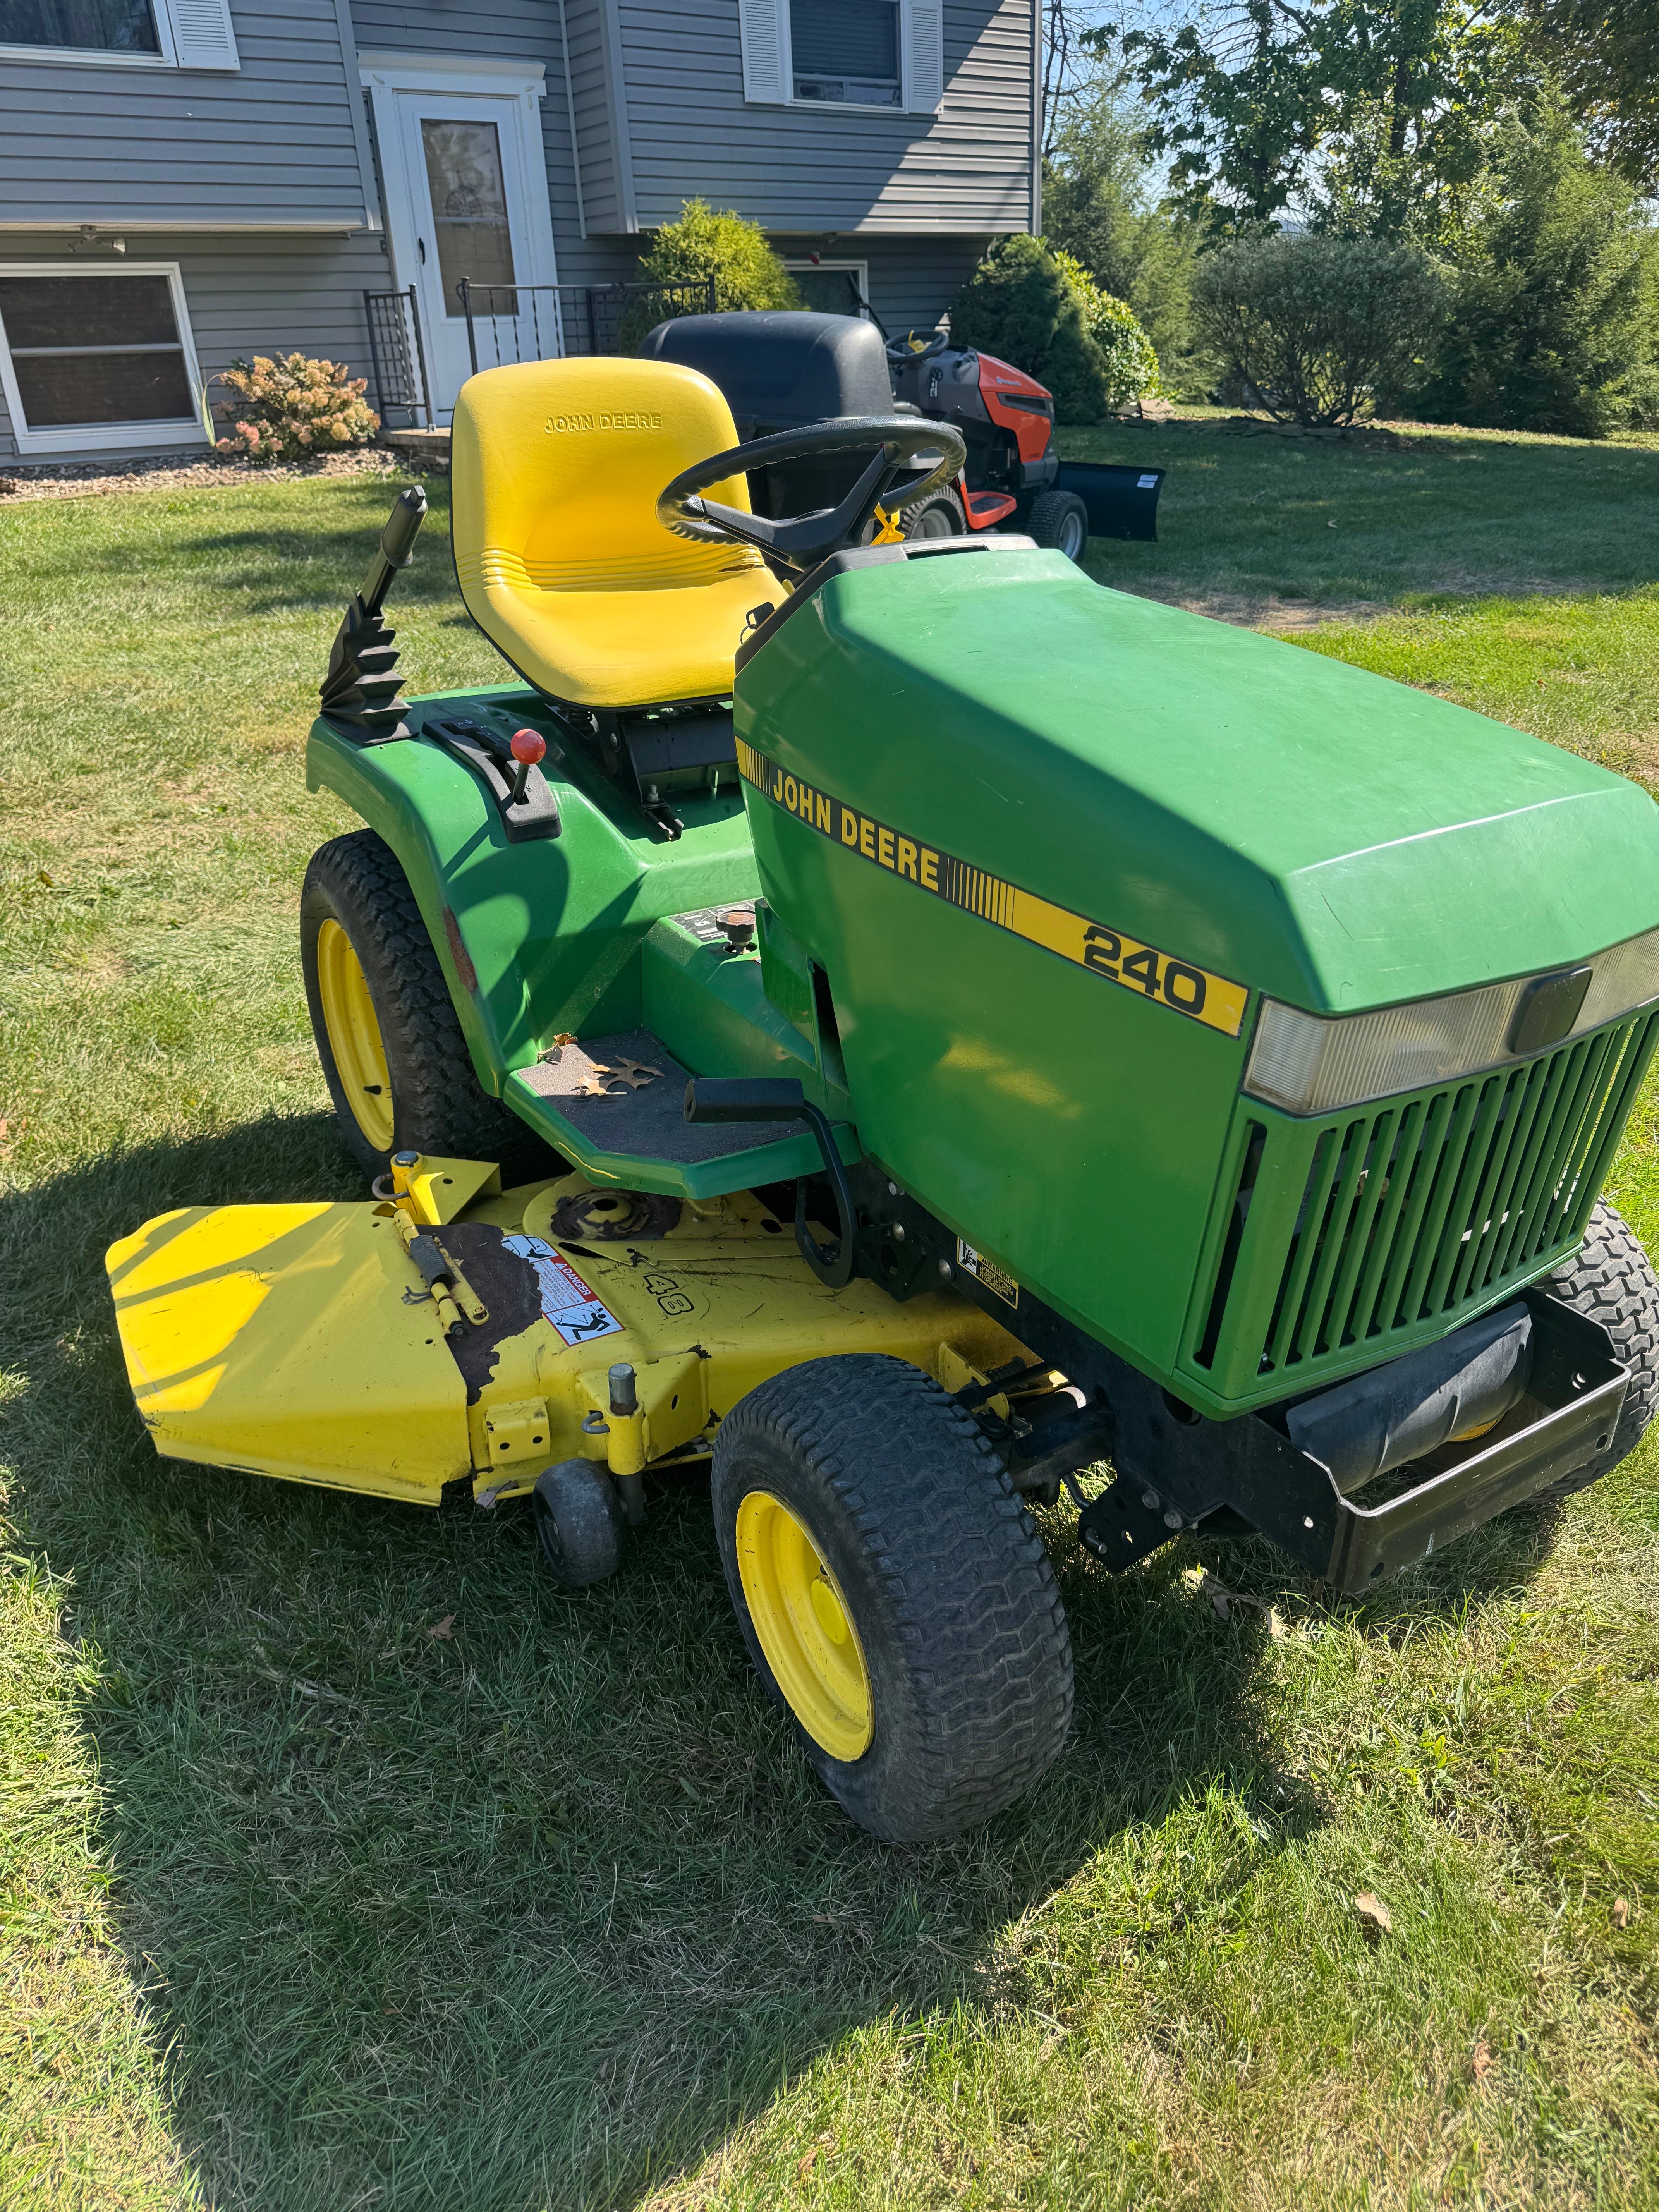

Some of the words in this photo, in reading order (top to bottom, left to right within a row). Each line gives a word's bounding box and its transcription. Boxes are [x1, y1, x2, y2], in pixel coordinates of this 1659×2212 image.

[544, 414, 594, 434] JOHN
[599, 412, 662, 429] DEERE
[773, 769, 831, 834] JOHN
[840, 807, 940, 891] DEERE
[1084, 925, 1207, 1015] 240
[562, 1268, 591, 1295] DANGER
[987, 1260, 1013, 1284] WARNING
[643, 1273, 694, 1316] 48
